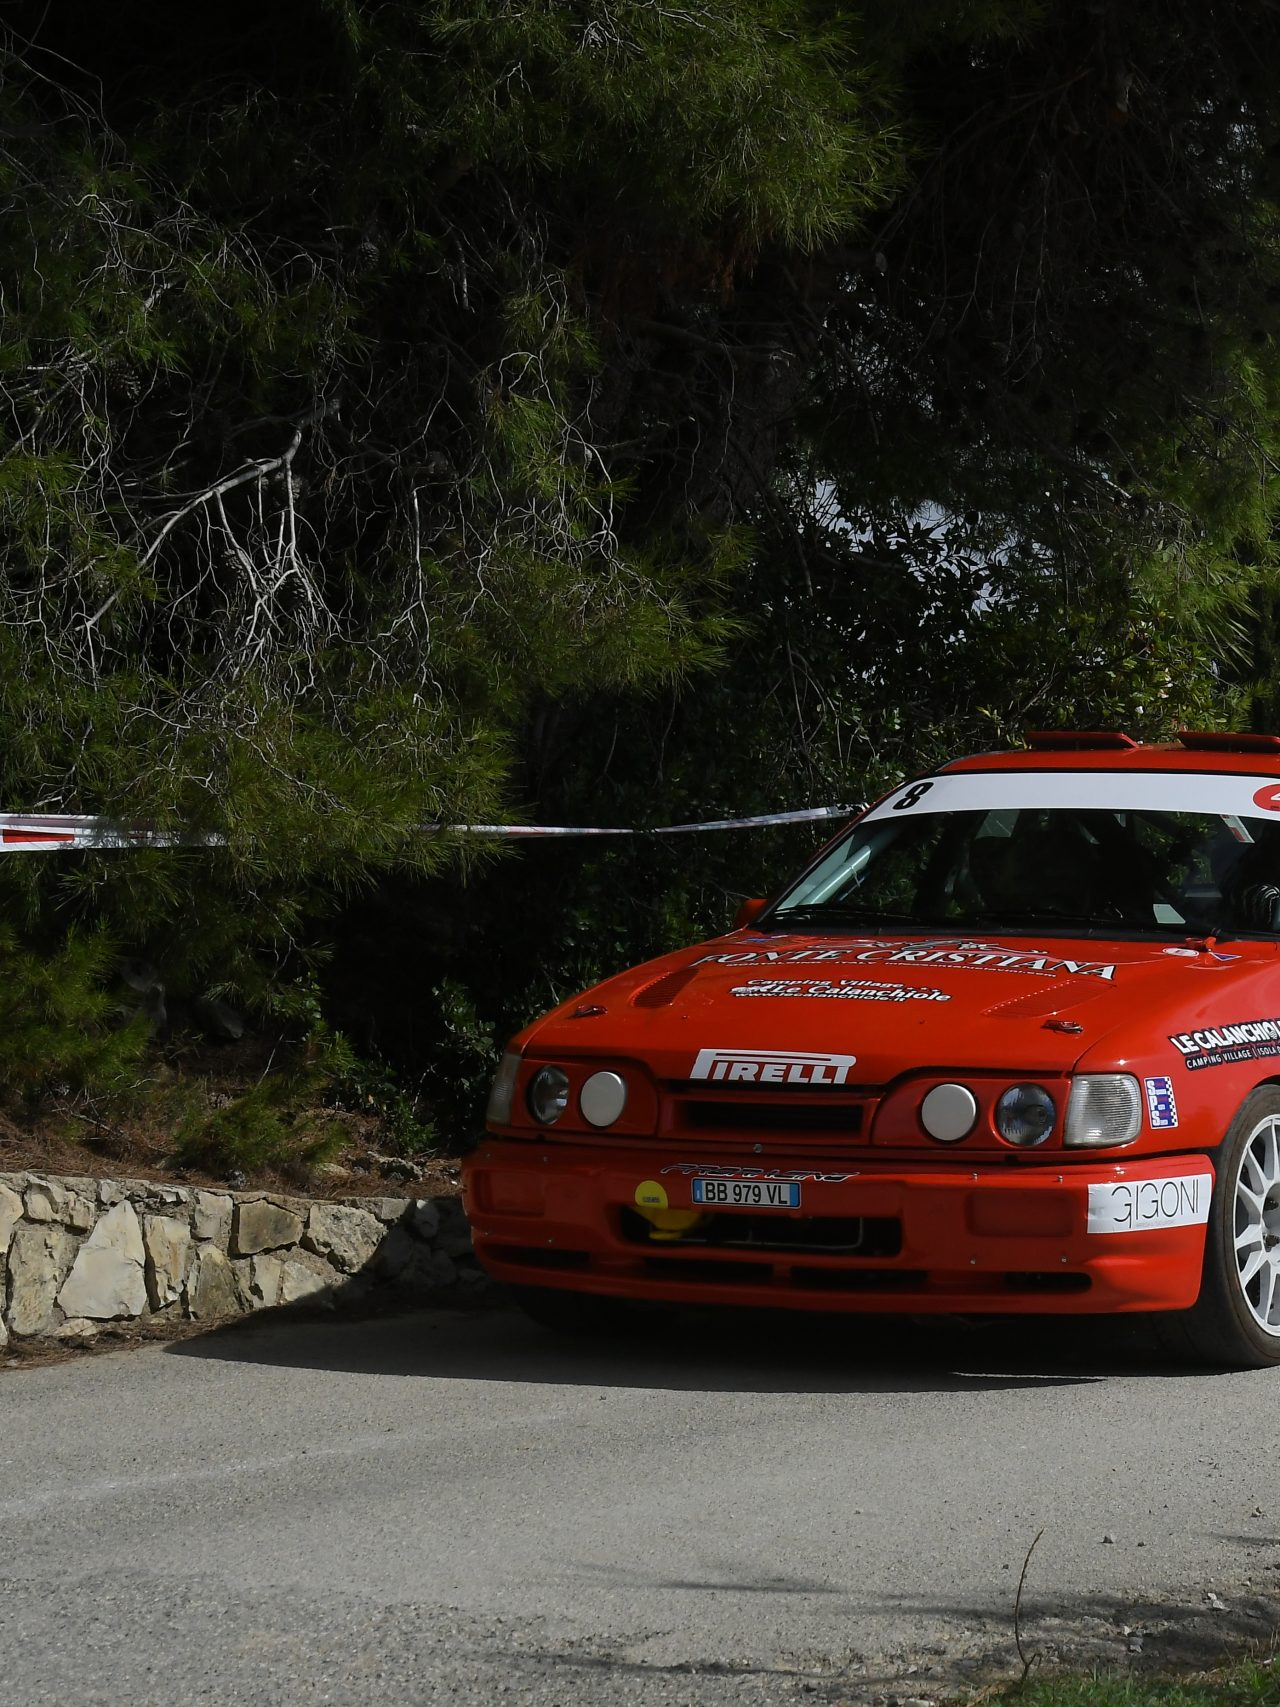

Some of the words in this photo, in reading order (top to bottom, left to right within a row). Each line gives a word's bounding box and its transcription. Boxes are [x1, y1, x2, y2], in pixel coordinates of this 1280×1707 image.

[892, 782, 934, 810] 8
[688, 950, 852, 968] FONTE
[857, 949, 1117, 980] CRISTIANA
[747, 979, 832, 987] Camping
[840, 979, 904, 988] Village
[770, 985, 802, 993] Le
[808, 985, 951, 1001] Calanchiole
[1170, 1034, 1200, 1053] LE
[690, 1048, 857, 1084] PIRELLI
[1186, 1054, 1221, 1069] CAMPING
[1223, 1049, 1251, 1061] VILLAGE
[1256, 1046, 1276, 1055] ISOLA
[705, 1182, 728, 1201] BB
[733, 1184, 761, 1203] 979
[766, 1185, 788, 1204] VL
[1111, 1179, 1199, 1229] GIGONI
